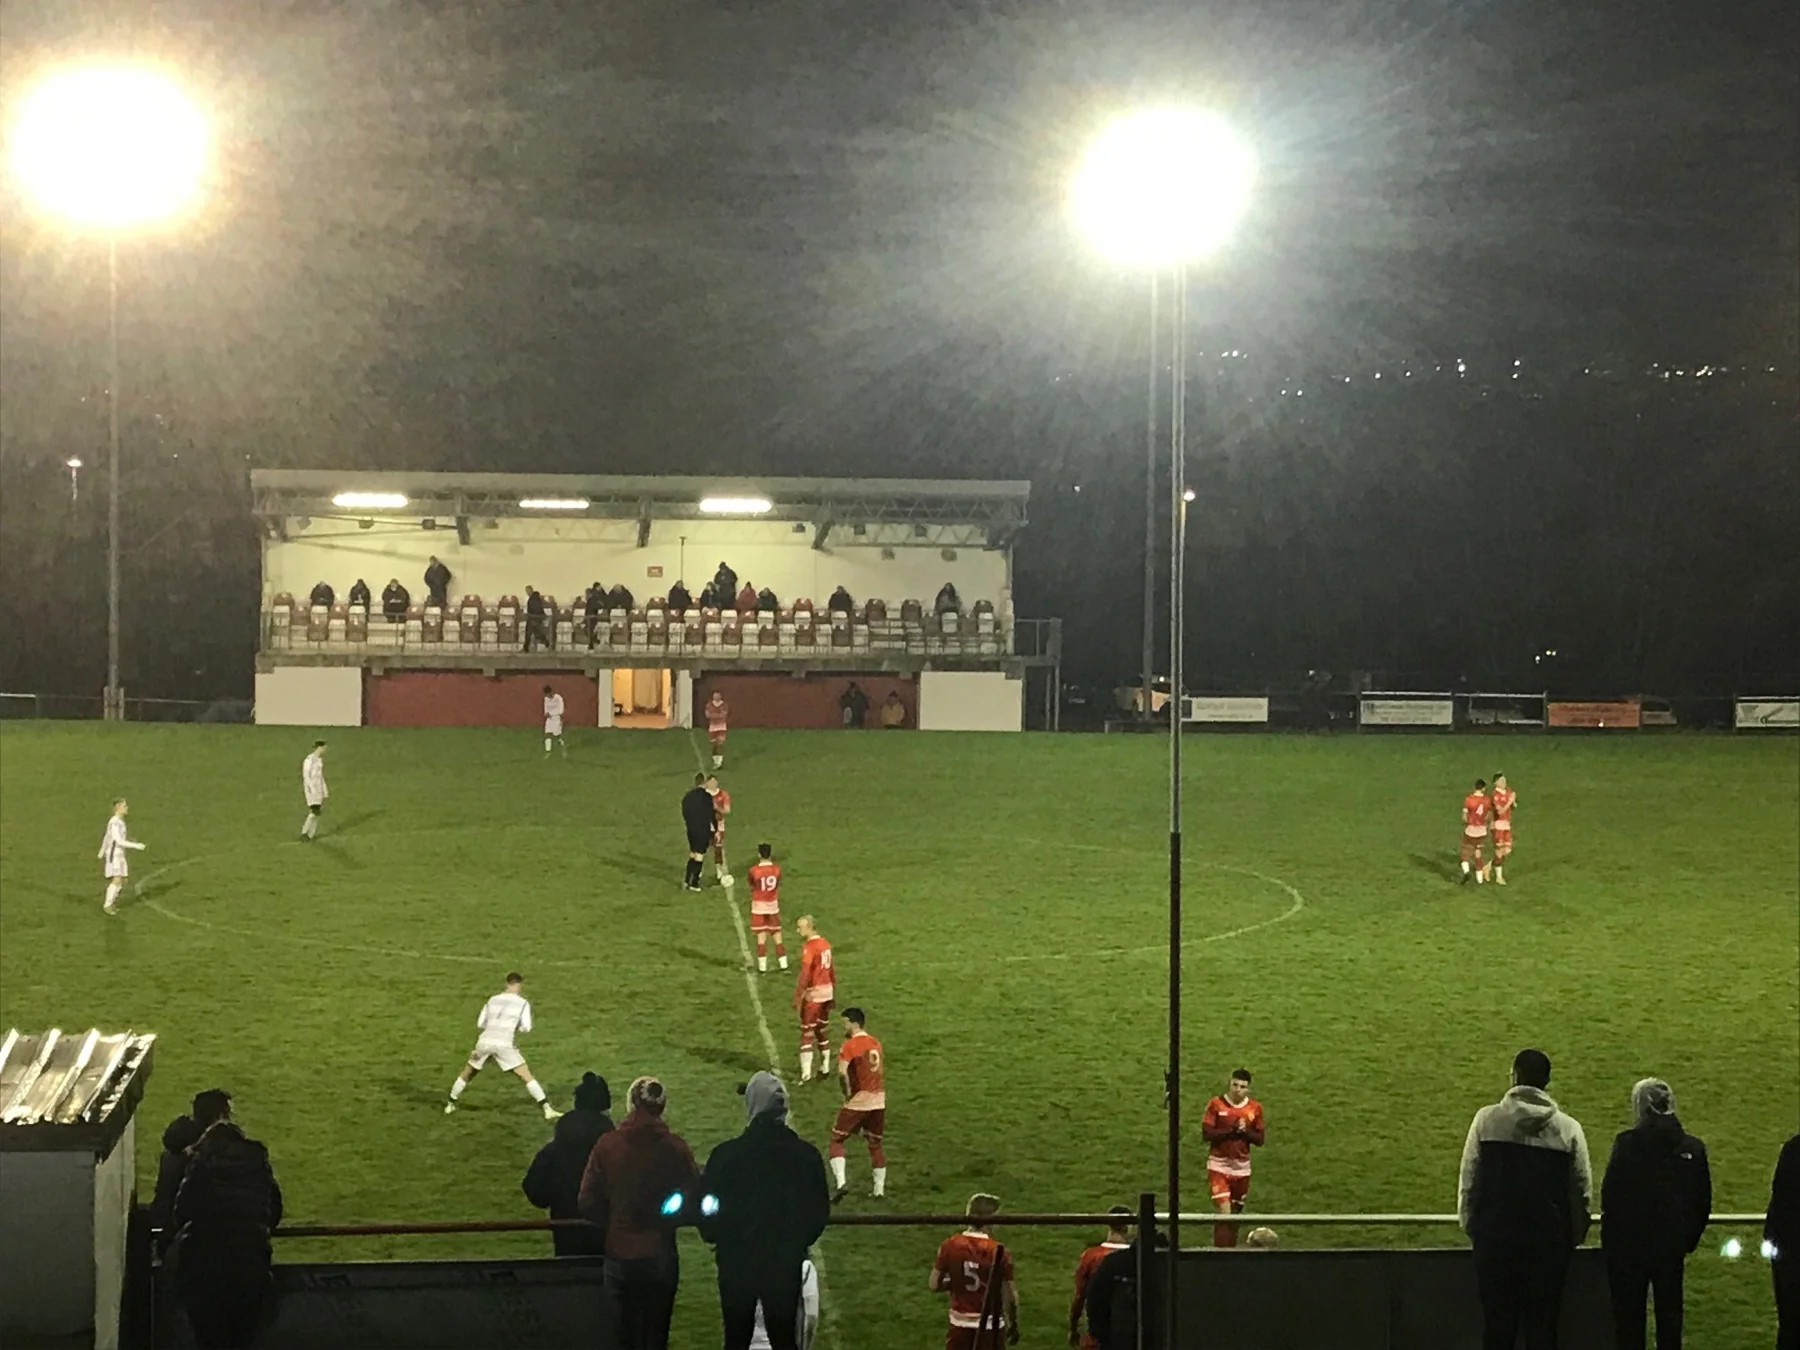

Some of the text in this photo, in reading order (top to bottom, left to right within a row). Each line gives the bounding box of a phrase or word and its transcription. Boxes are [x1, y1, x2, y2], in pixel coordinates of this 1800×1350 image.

[760, 875, 777, 892] 19
[868, 1048, 880, 1073] 9
[963, 1260, 980, 1292] 5
